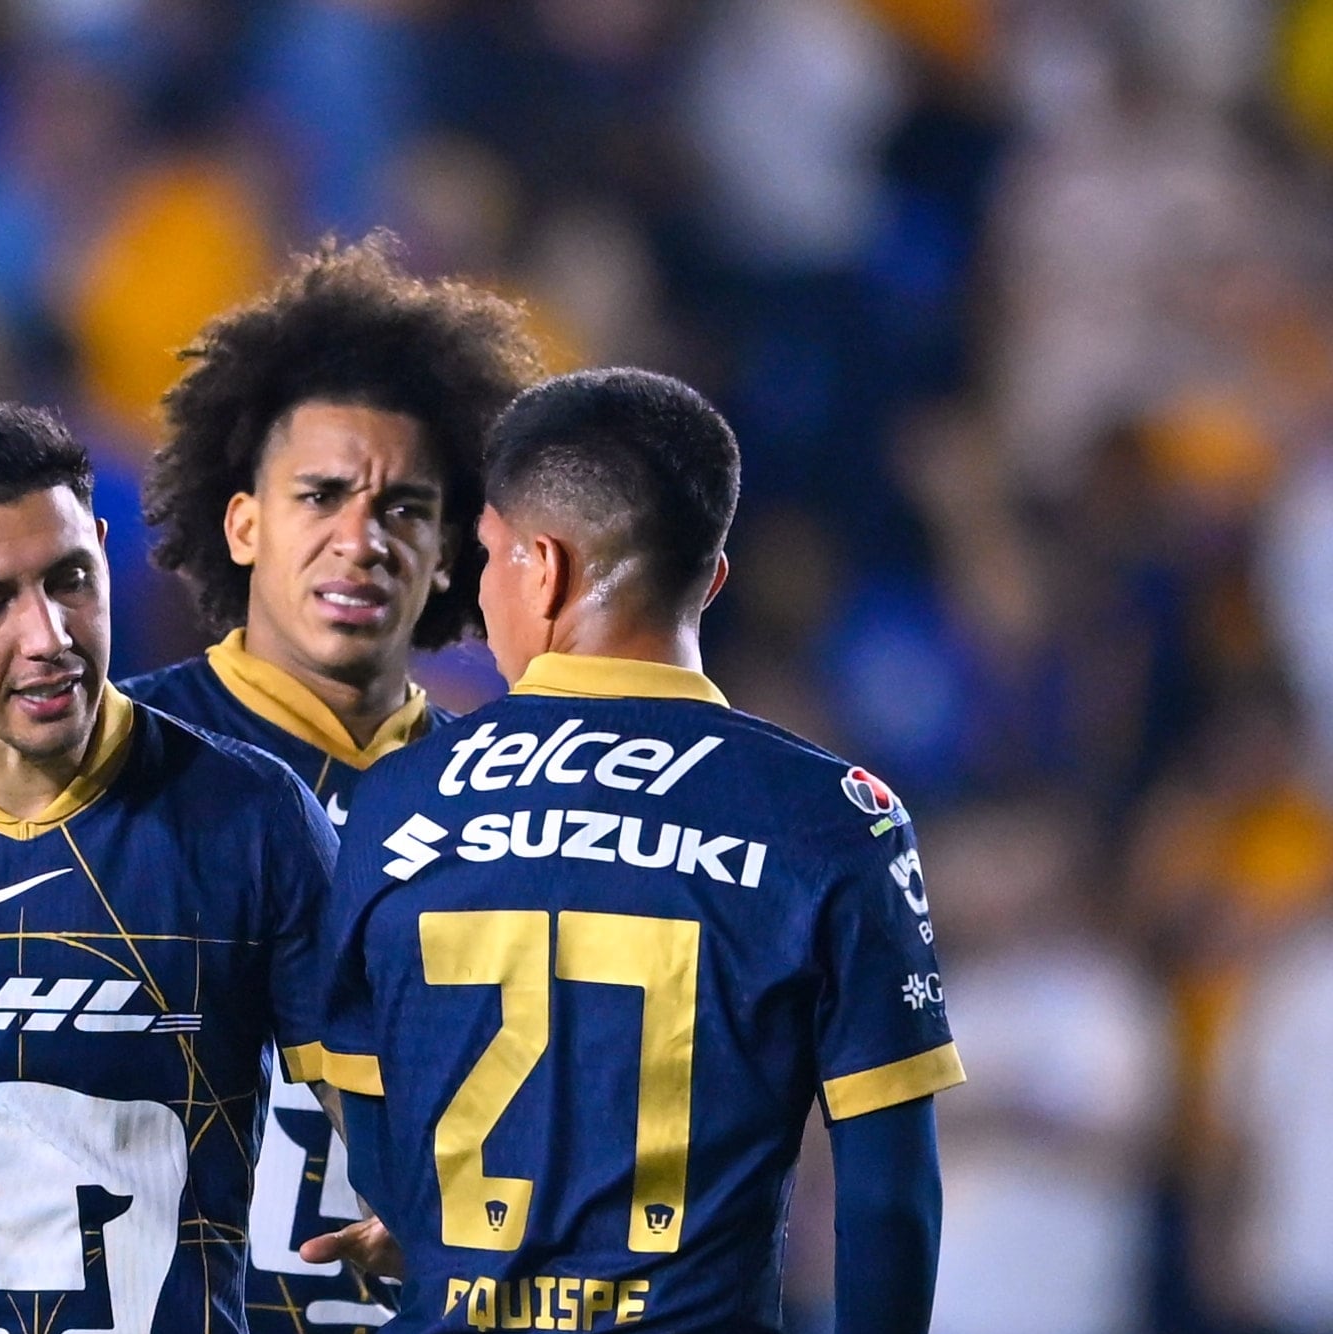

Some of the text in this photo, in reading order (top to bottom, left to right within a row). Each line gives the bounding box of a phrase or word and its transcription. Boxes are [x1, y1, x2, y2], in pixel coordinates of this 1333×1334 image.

[437, 717, 726, 797] telcel
[455, 808, 768, 889] SUZUKI
[417, 909, 702, 1254] 27
